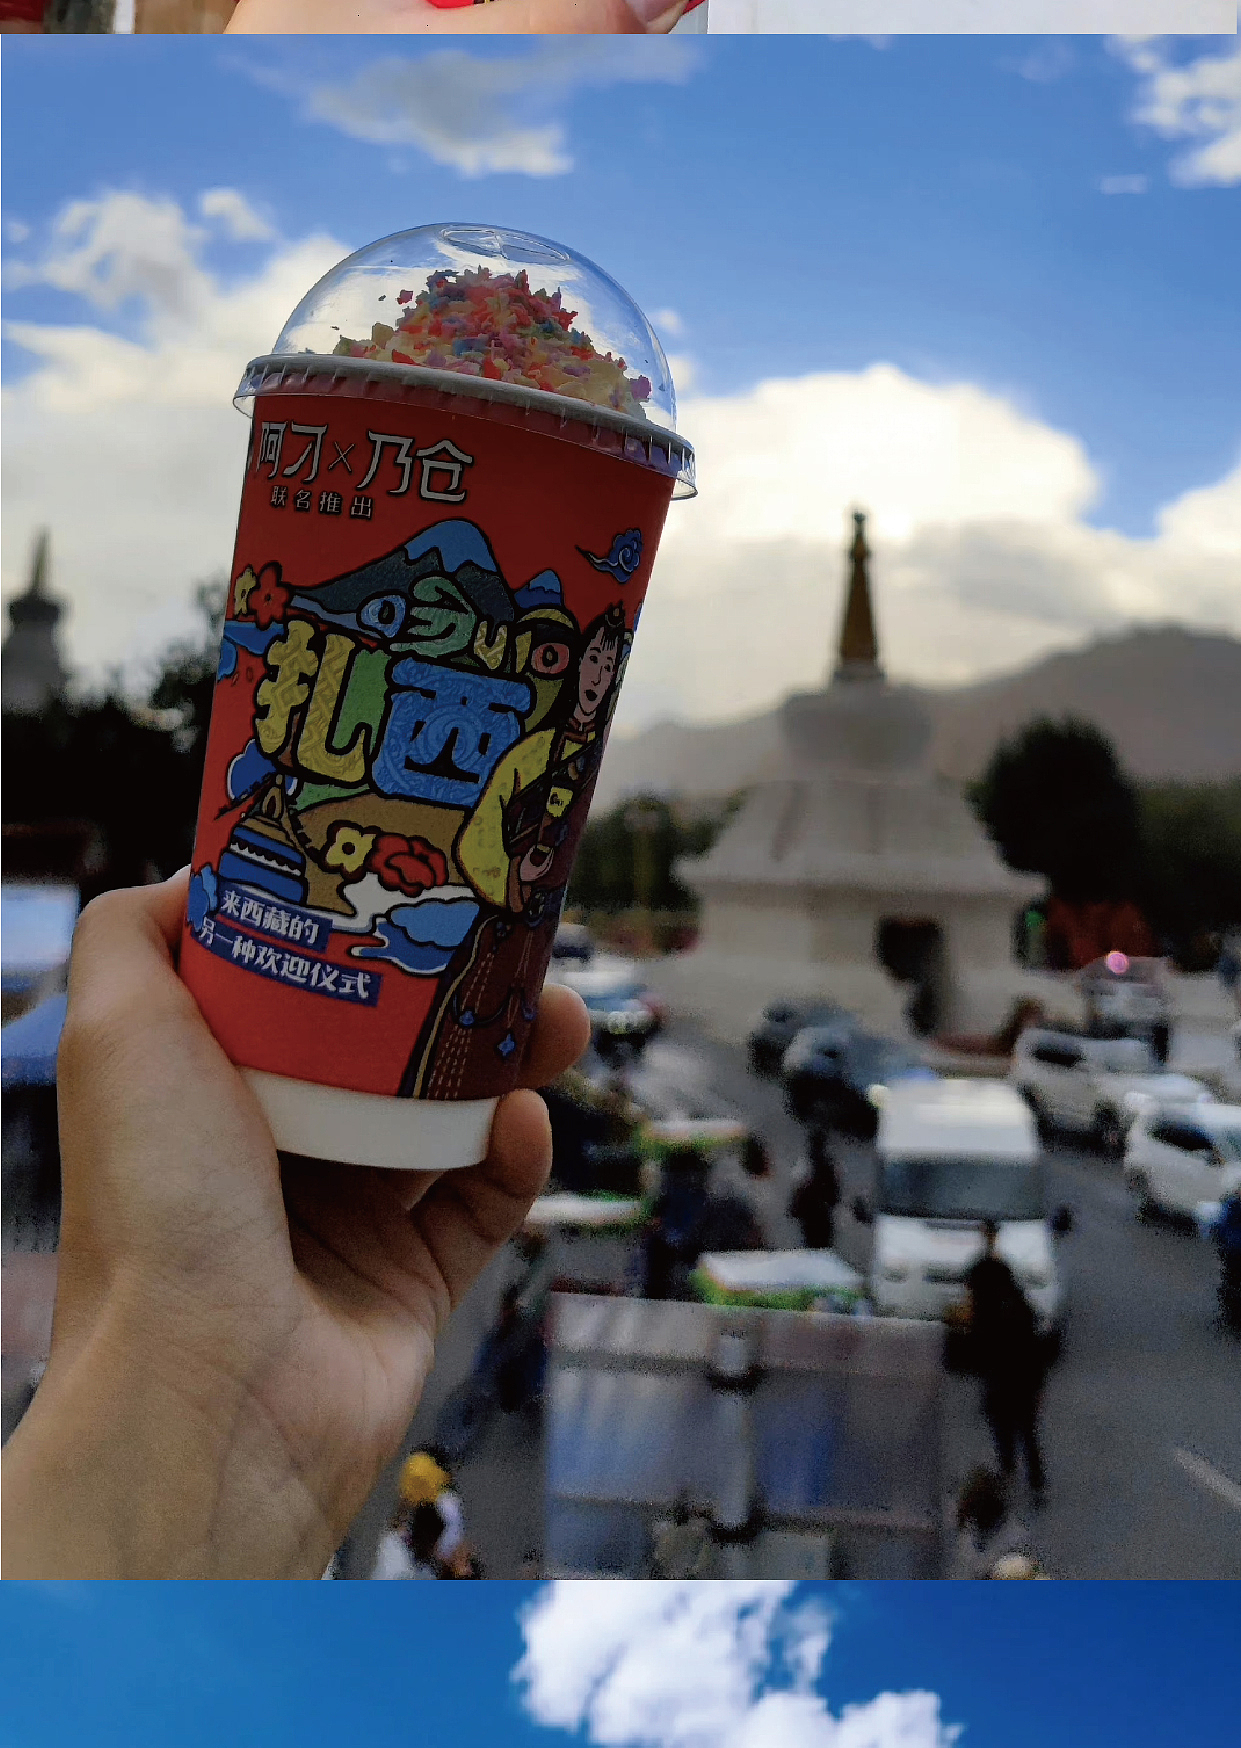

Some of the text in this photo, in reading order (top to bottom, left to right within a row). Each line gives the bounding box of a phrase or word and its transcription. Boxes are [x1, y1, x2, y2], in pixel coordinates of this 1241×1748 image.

[270, 485, 373, 520] 联名推出
[253, 618, 535, 809] 扎西
[220, 889, 320, 945] 来西藏的
[199, 916, 372, 1000] 另一种欢迎仪式
